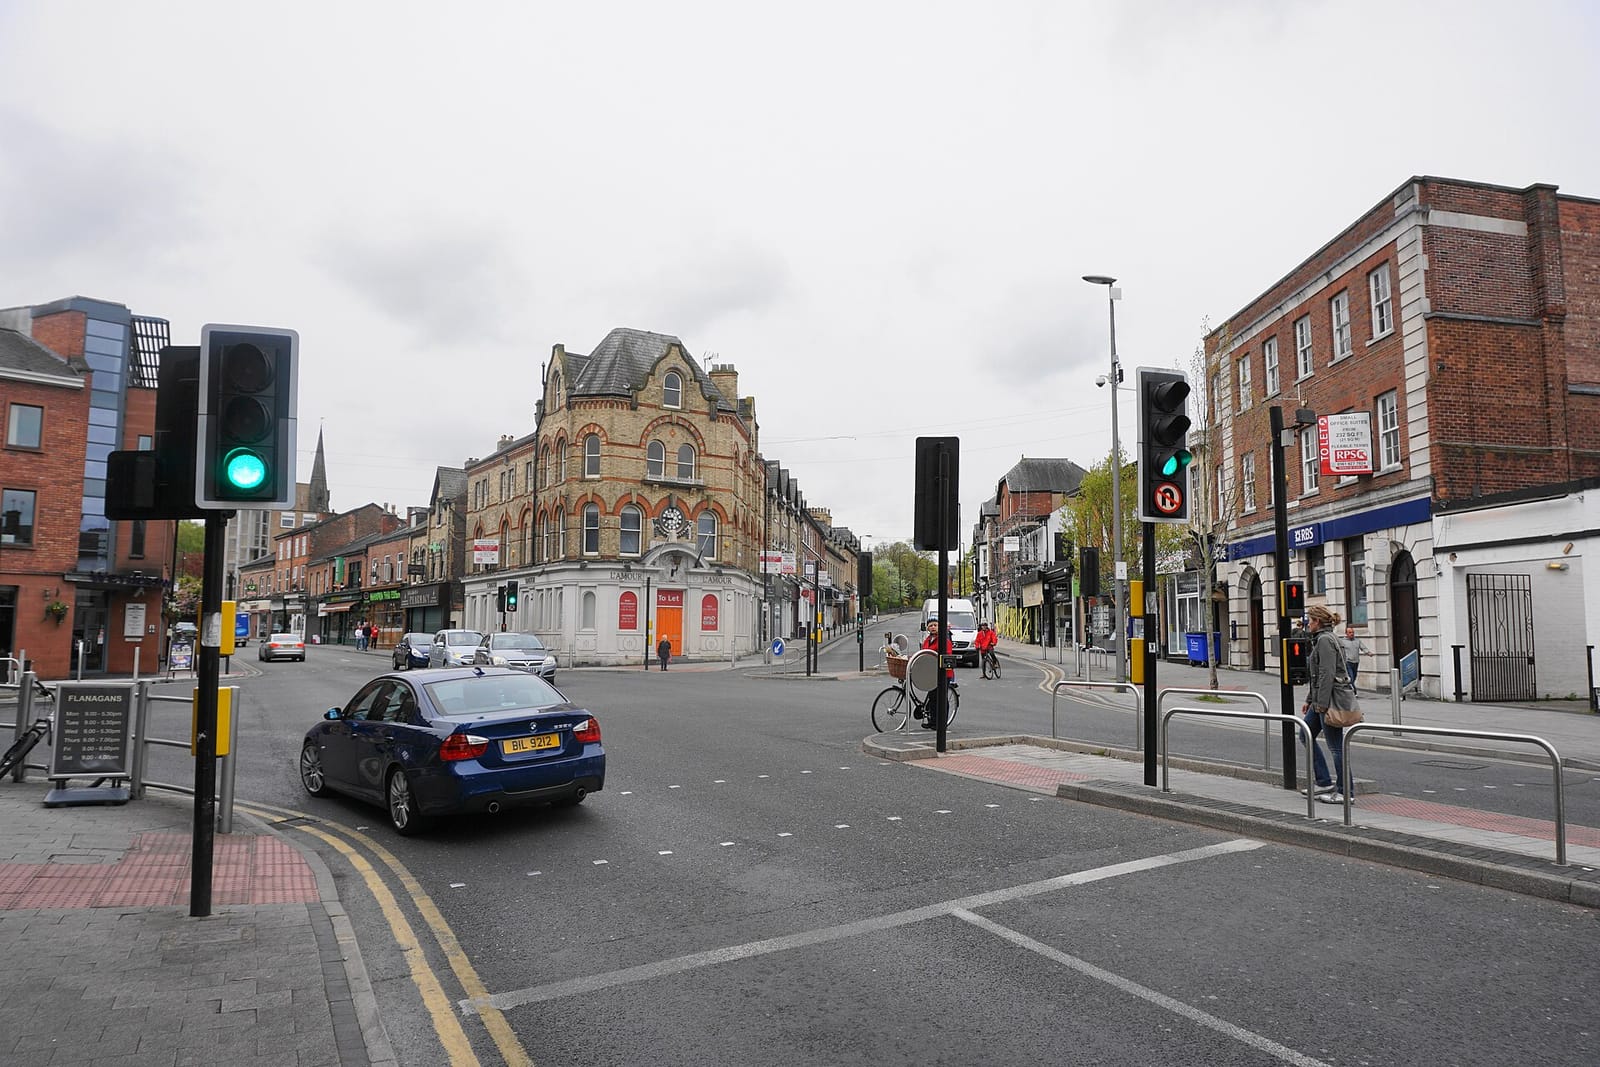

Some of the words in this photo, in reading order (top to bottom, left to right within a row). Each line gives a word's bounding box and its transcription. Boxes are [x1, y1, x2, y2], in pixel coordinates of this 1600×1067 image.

[1319, 427, 1328, 446] LET
[1320, 448, 1329, 462] TO
[1301, 526, 1314, 541] RBS
[610, 571, 642, 580] L'AMOUR
[702, 576, 732, 584] L'AMOUR
[512, 740, 528, 751] BIL
[530, 736, 552, 748] 9212
